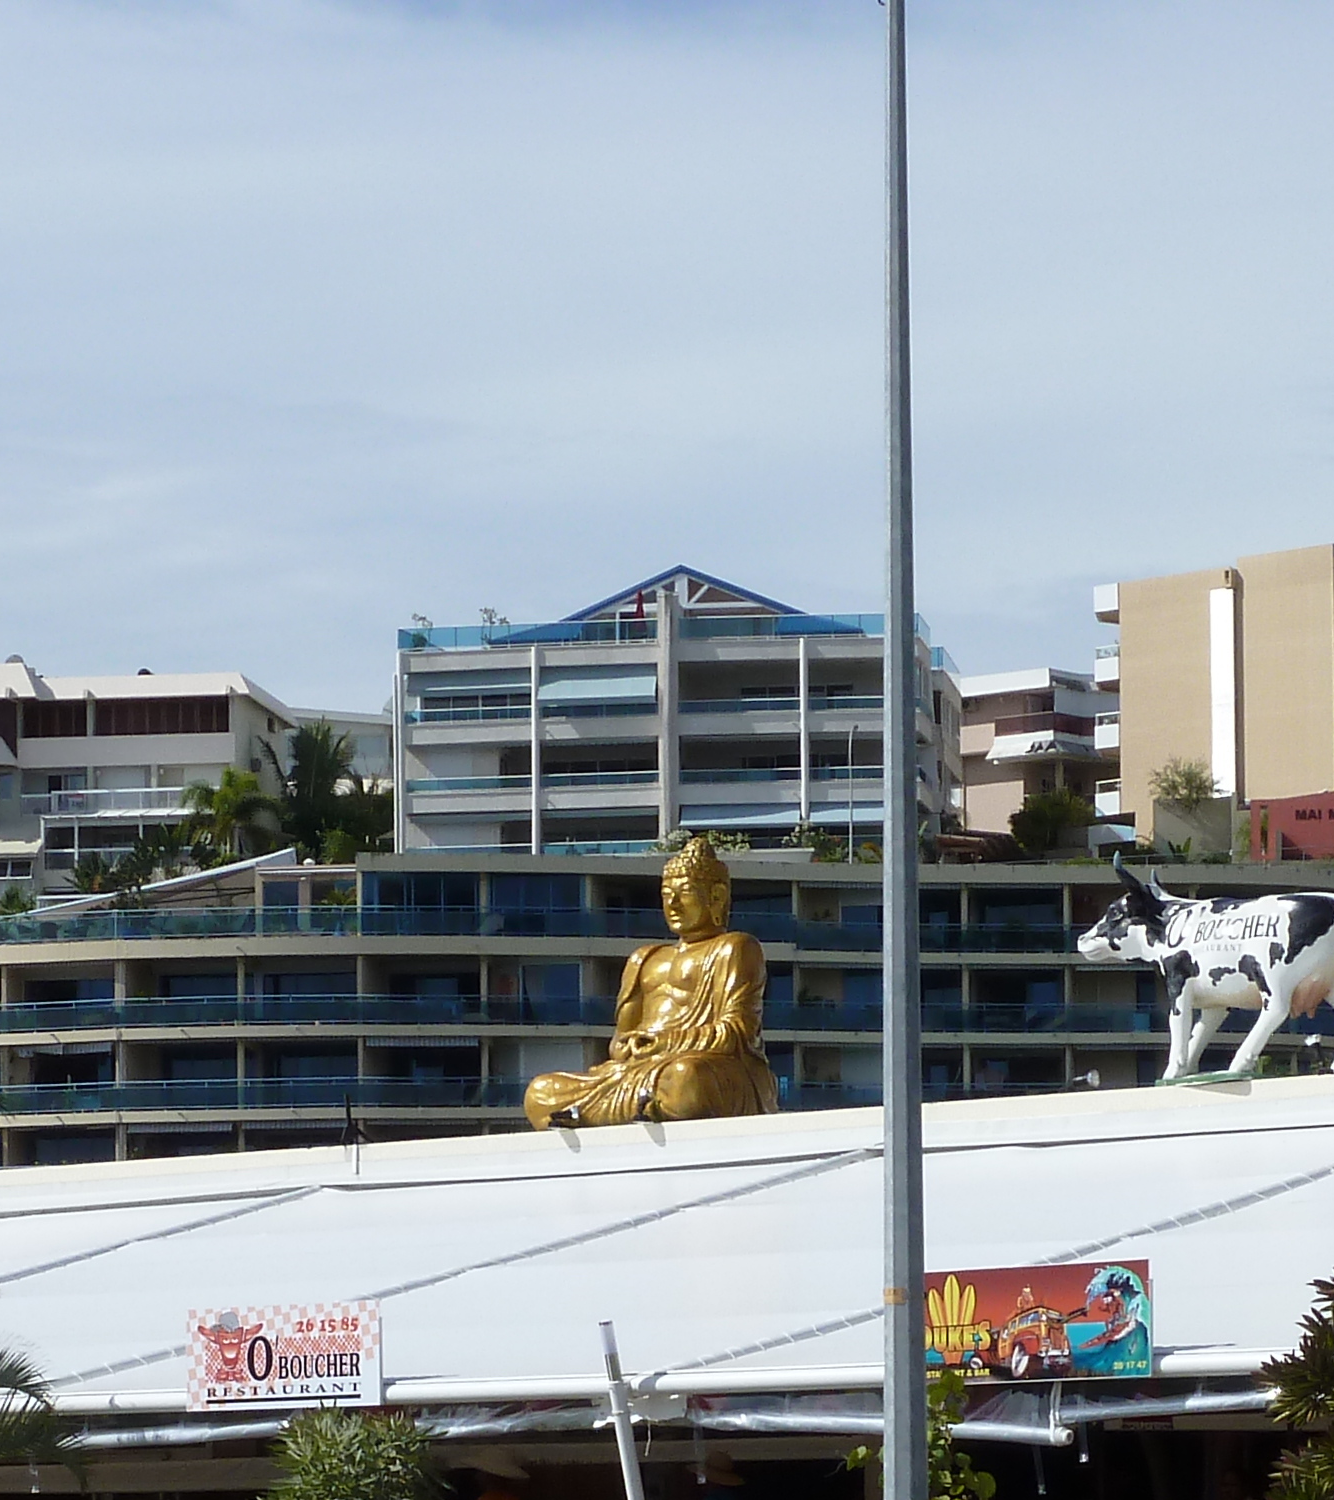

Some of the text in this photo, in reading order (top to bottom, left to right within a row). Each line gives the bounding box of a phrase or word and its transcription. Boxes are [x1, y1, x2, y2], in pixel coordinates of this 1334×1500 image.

[296, 1316, 359, 1334] 26 15 85
[207, 1382, 362, 1398] RESTAURANT
